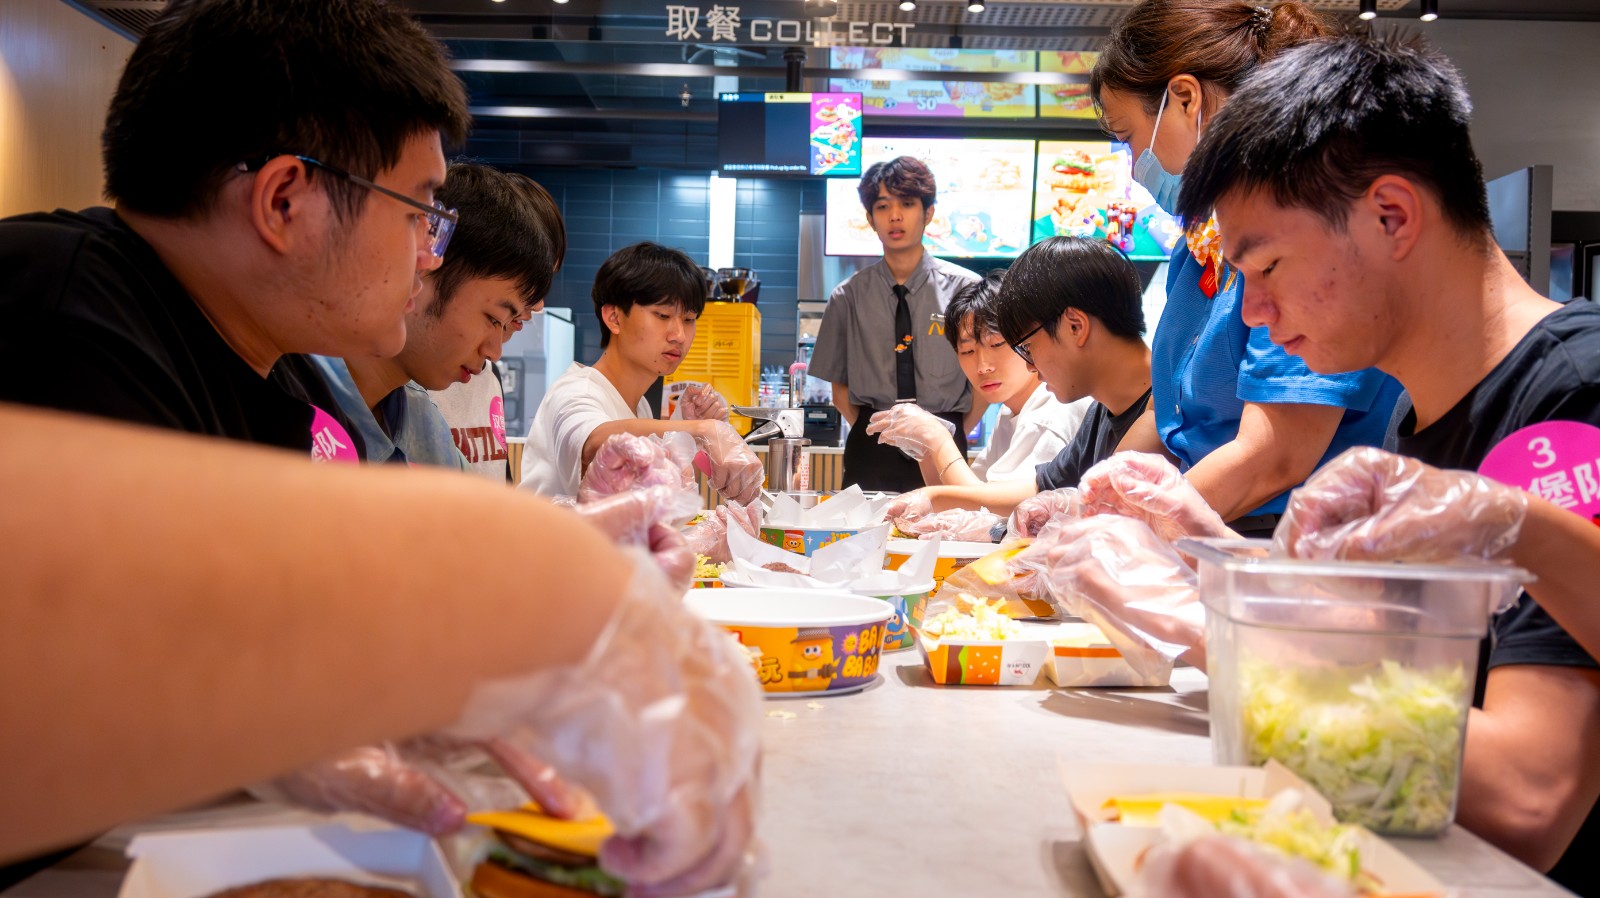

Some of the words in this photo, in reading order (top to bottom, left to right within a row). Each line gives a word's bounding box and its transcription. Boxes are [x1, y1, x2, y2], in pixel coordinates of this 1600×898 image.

[665, 4, 741, 42] 取餐
[750, 19, 915, 45] COLLECT
[1527, 436, 1557, 469] 3
